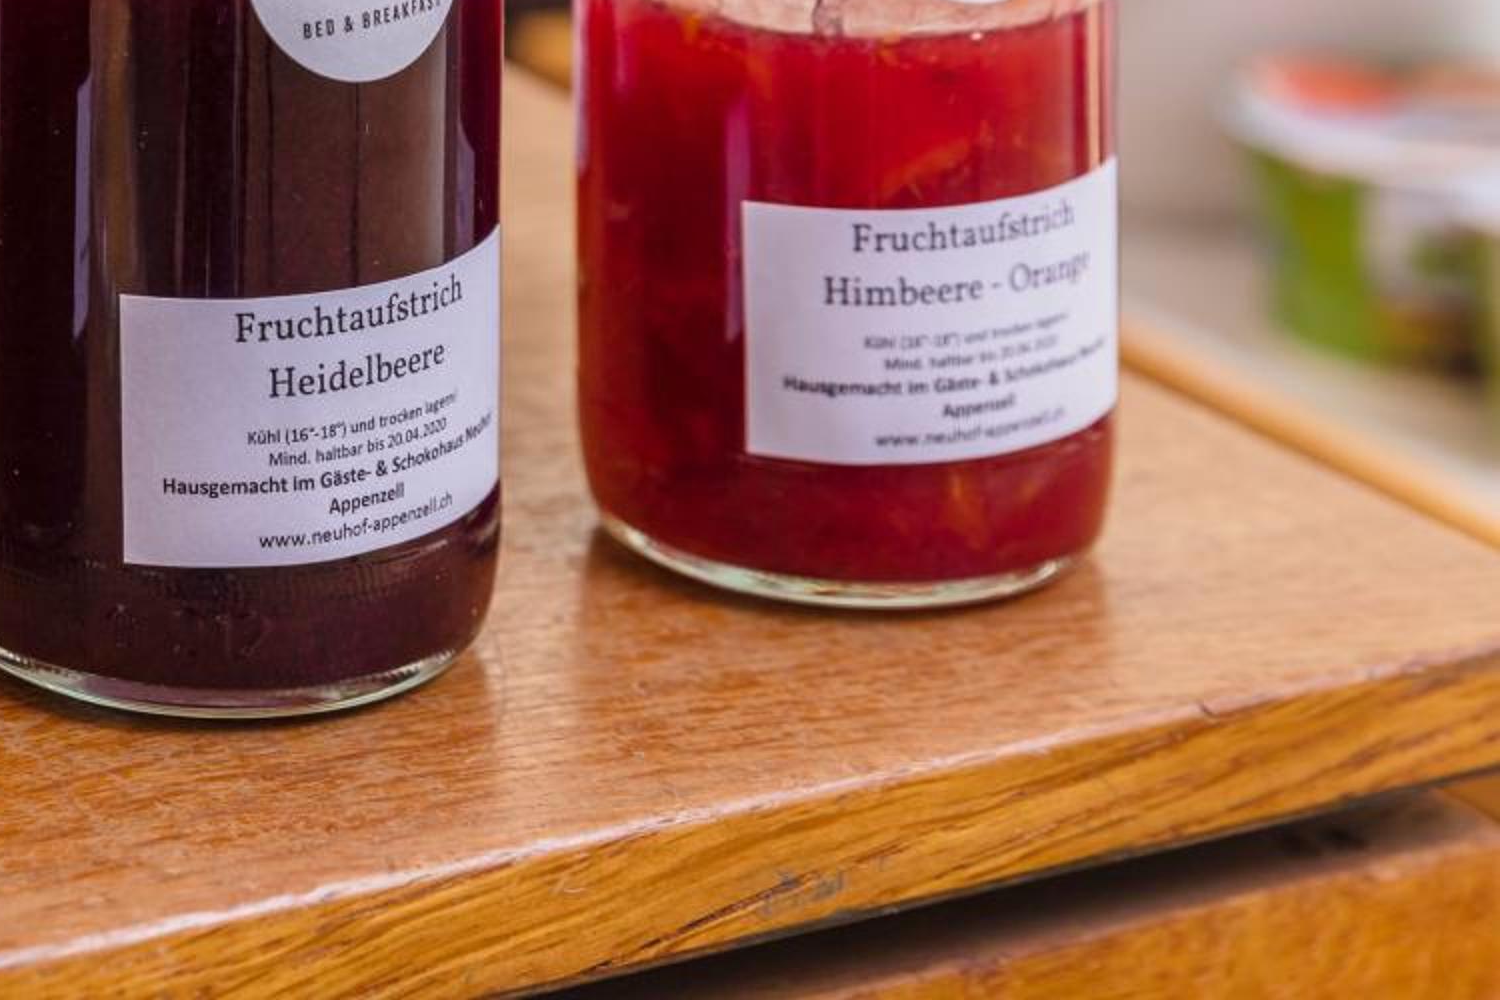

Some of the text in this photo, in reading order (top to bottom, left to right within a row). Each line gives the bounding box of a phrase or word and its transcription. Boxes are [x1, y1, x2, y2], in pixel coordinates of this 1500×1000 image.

[303, 18, 335, 40] BED
[343, 15, 354, 34] &
[852, 197, 1075, 254] Fruchtaufstrich
[823, 274, 984, 309] Himbeere
[1008, 252, 1092, 293] Orange
[235, 272, 463, 343] Fruchtaufstrich
[269, 342, 445, 399] Heidelbeere
[783, 374, 904, 398] Hausgemacht
[908, 380, 930, 395] im
[989, 369, 999, 386] &
[247, 428, 281, 446] Kühl
[351, 416, 375, 434] und
[380, 405, 423, 427] trocken
[944, 394, 1016, 419] Appenzell
[163, 476, 288, 499] Hausgemacht
[293, 476, 315, 492] im
[320, 468, 372, 490] Gäste-
[375, 460, 389, 478] &
[392, 432, 464, 473] Schokohaus
[269, 417, 448, 467] Mind. haltbar bis 20.04.2020
[259, 490, 453, 549] www.neuhof-appenzell.ch
[329, 481, 406, 516] Appenzell
